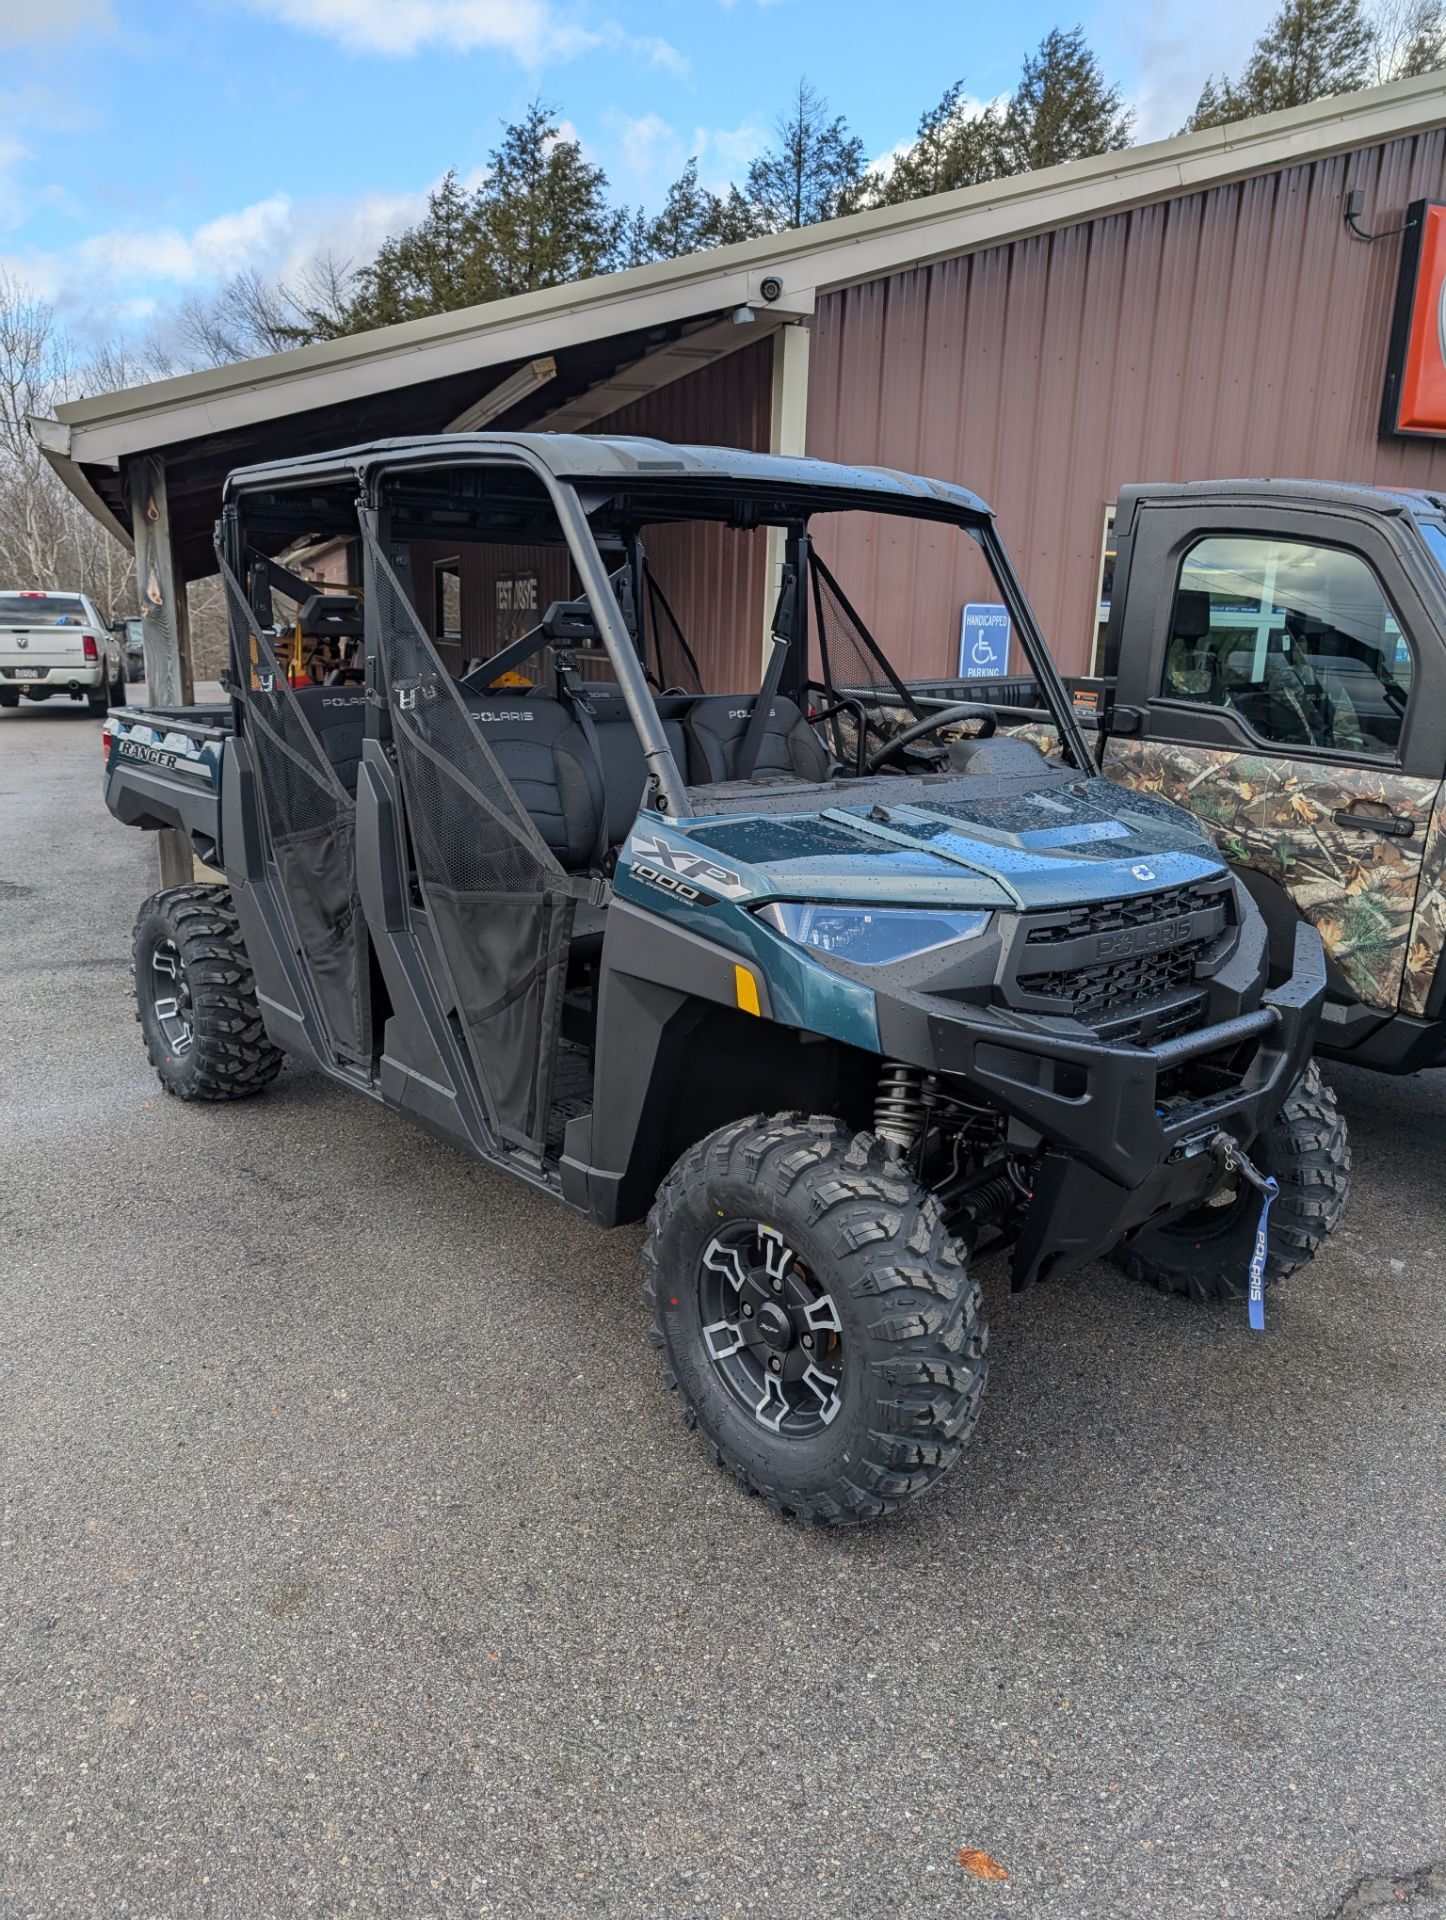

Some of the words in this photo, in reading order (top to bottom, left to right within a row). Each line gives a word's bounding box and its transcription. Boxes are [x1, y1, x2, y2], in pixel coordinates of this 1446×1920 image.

[966, 614, 1008, 627] HANDICAPPED
[967, 667, 1000, 678] PARKING
[120, 741, 177, 770] RANGER
[630, 861, 700, 900] 1000
[631, 836, 746, 894] XP
[1096, 920, 1191, 960] POLARIS
[1250, 1230, 1265, 1301] POLARIS
